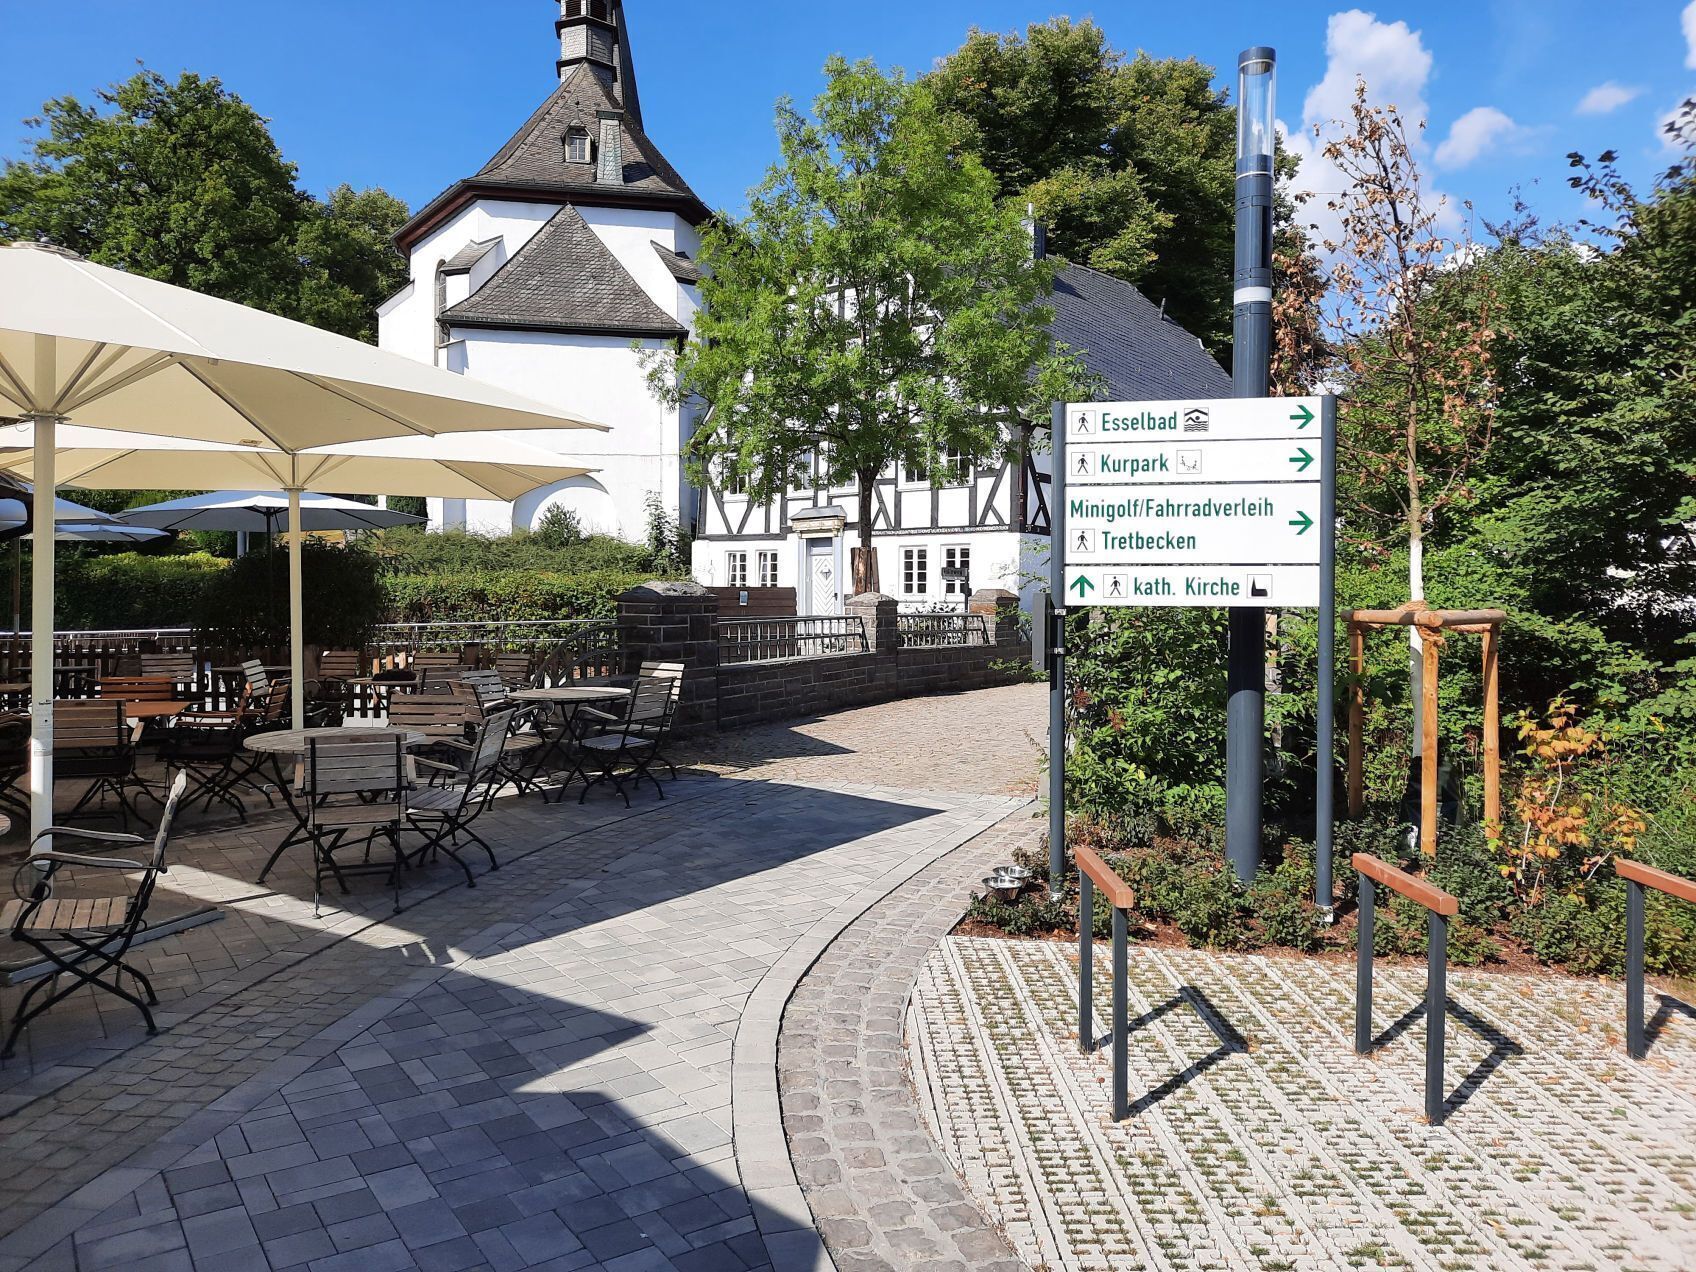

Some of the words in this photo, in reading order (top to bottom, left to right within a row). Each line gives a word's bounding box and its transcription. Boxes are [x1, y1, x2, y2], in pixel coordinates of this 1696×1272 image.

[1102, 412, 1176, 431] Esselbad
[1102, 453, 1168, 477] Kurpark
[1071, 498, 1273, 522] Minigolf/Fahrradverleih
[1102, 531, 1195, 549] Tretbecken
[1134, 577, 1175, 595] kath.
[1186, 577, 1239, 595] Kirche
